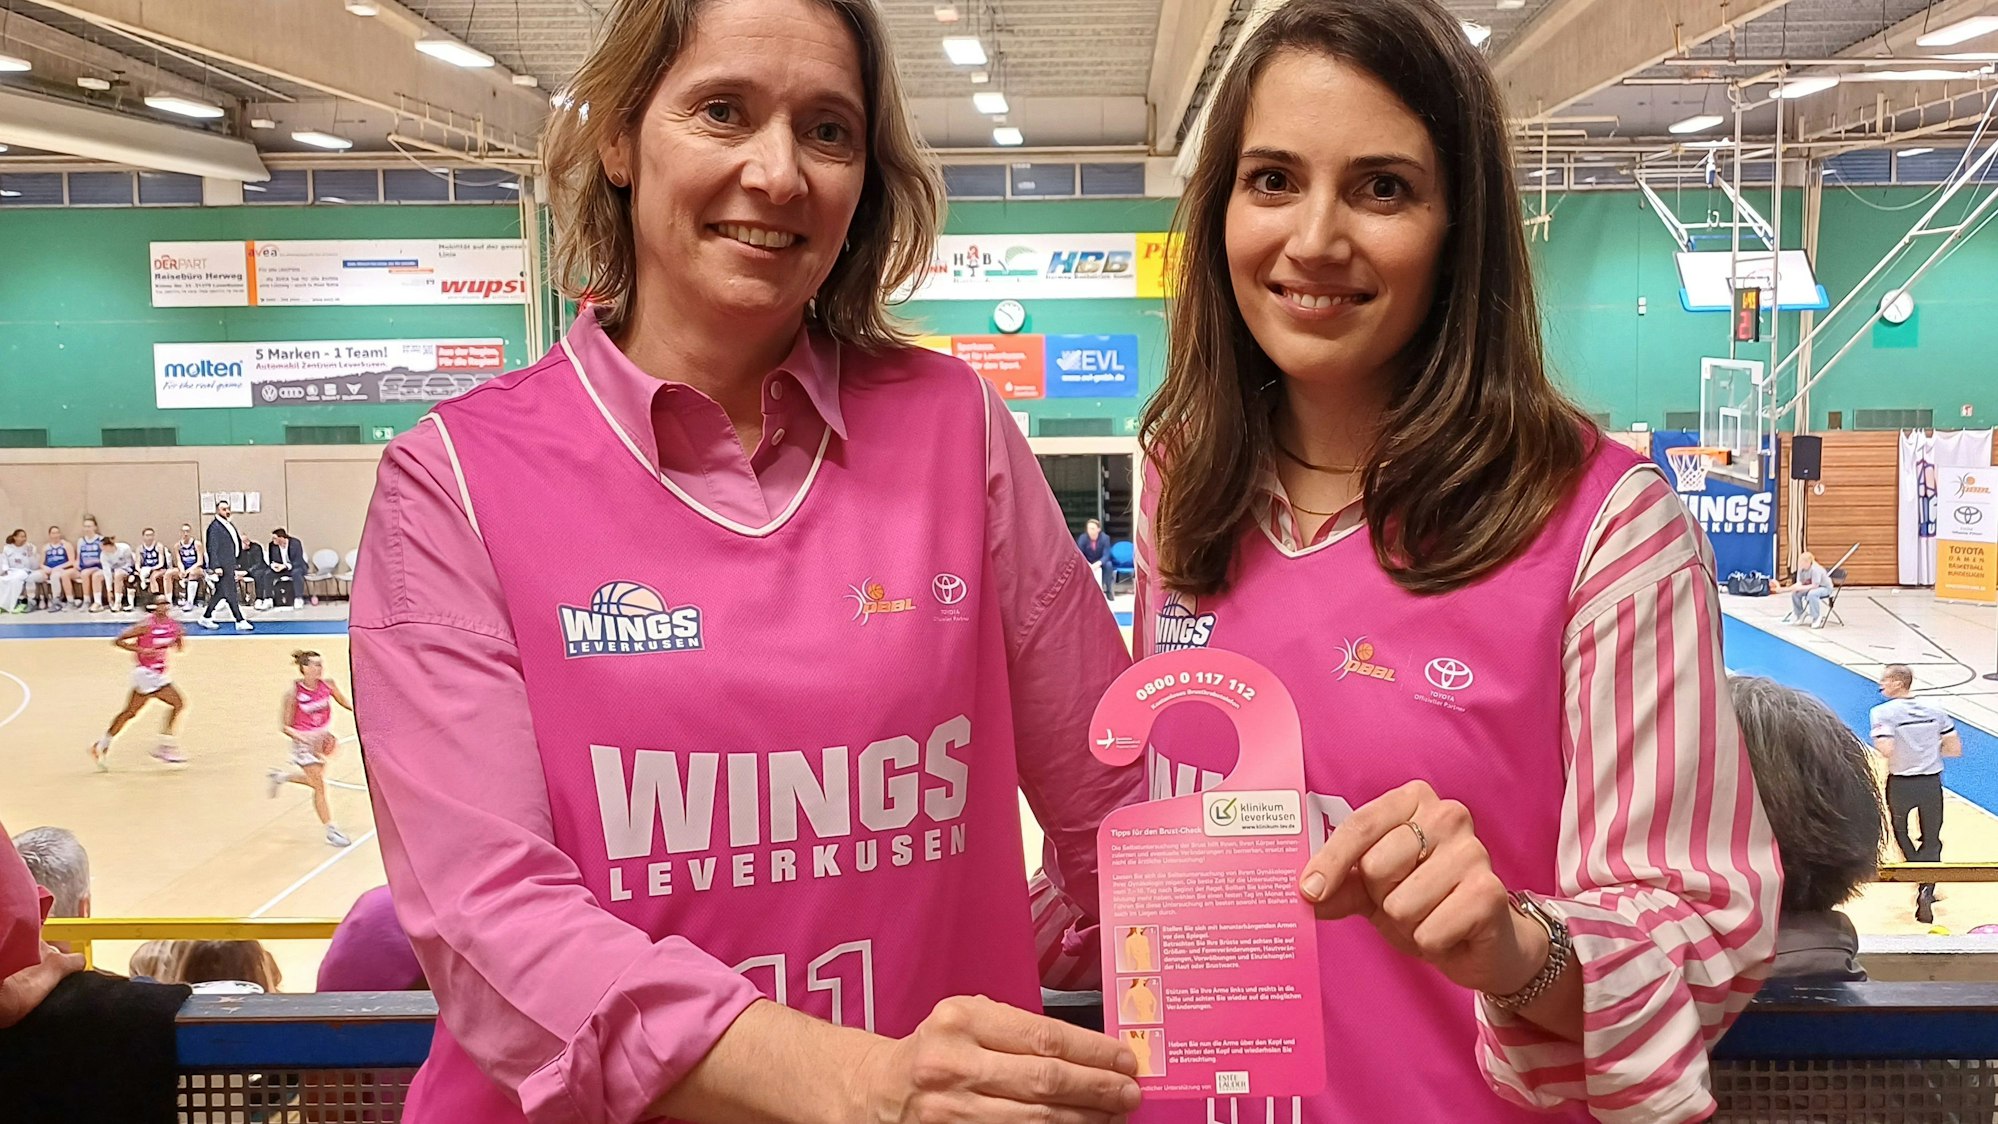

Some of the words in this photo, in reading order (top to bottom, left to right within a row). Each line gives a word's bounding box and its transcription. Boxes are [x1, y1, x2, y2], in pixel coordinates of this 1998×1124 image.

[248, 247, 278, 257] avea
[154, 256, 207, 270] DERPART
[1045, 251, 1132, 273] HBB
[155, 273, 203, 281] Reisebüro
[205, 272, 243, 281] Herweg
[441, 280, 525, 299] wupsi
[255, 348, 264, 360] 5
[267, 346, 320, 360] Marken
[334, 347, 341, 359] 1
[345, 346, 388, 359] Team!
[1082, 349, 1125, 371] EVL
[164, 359, 242, 378] molten
[256, 361, 299, 370] Automobil
[302, 361, 336, 369] Zentrum
[1700, 522, 1769, 533] RKUSEN
[1949, 545, 1984, 556] TOYOTA
[561, 607, 699, 642] WINGS
[568, 638, 700, 654] LEVERKUSEN
[1136, 674, 1175, 701] 0800
[1179, 671, 1190, 685] 0
[1195, 671, 1224, 686] 117
[1228, 679, 1256, 702] 112
[1430, 690, 1455, 703] TOYOTA
[1443, 700, 1466, 713] Partner
[590, 713, 972, 861] WINGS
[1240, 802, 1284, 812] klinikum
[1240, 812, 1296, 822] leverkusen
[1112, 829, 1131, 838] Tipps
[1144, 828, 1158, 836] den
[1159, 826, 1202, 835] Brust-Check
[609, 822, 967, 902] LEVERKUSEN
